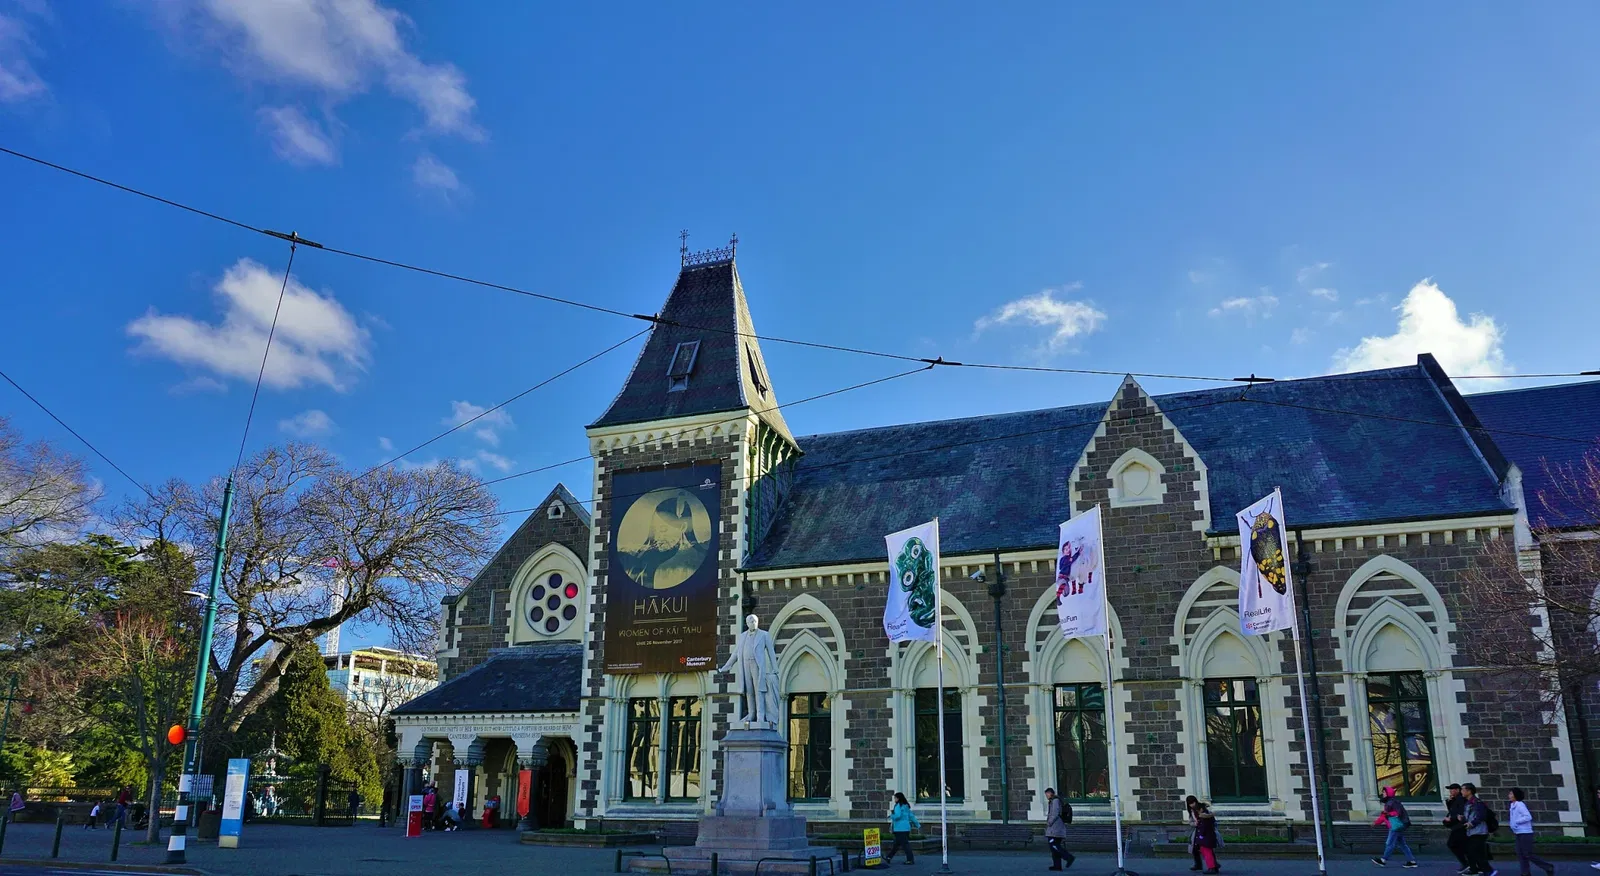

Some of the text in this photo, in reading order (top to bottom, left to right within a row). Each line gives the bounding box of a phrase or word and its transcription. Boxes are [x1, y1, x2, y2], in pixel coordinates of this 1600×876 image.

[634, 595, 688, 615] HĀKUI
[1244, 606, 1271, 618] RealLife
[618, 626, 702, 637] WOMEN OF KĀI TAHU
